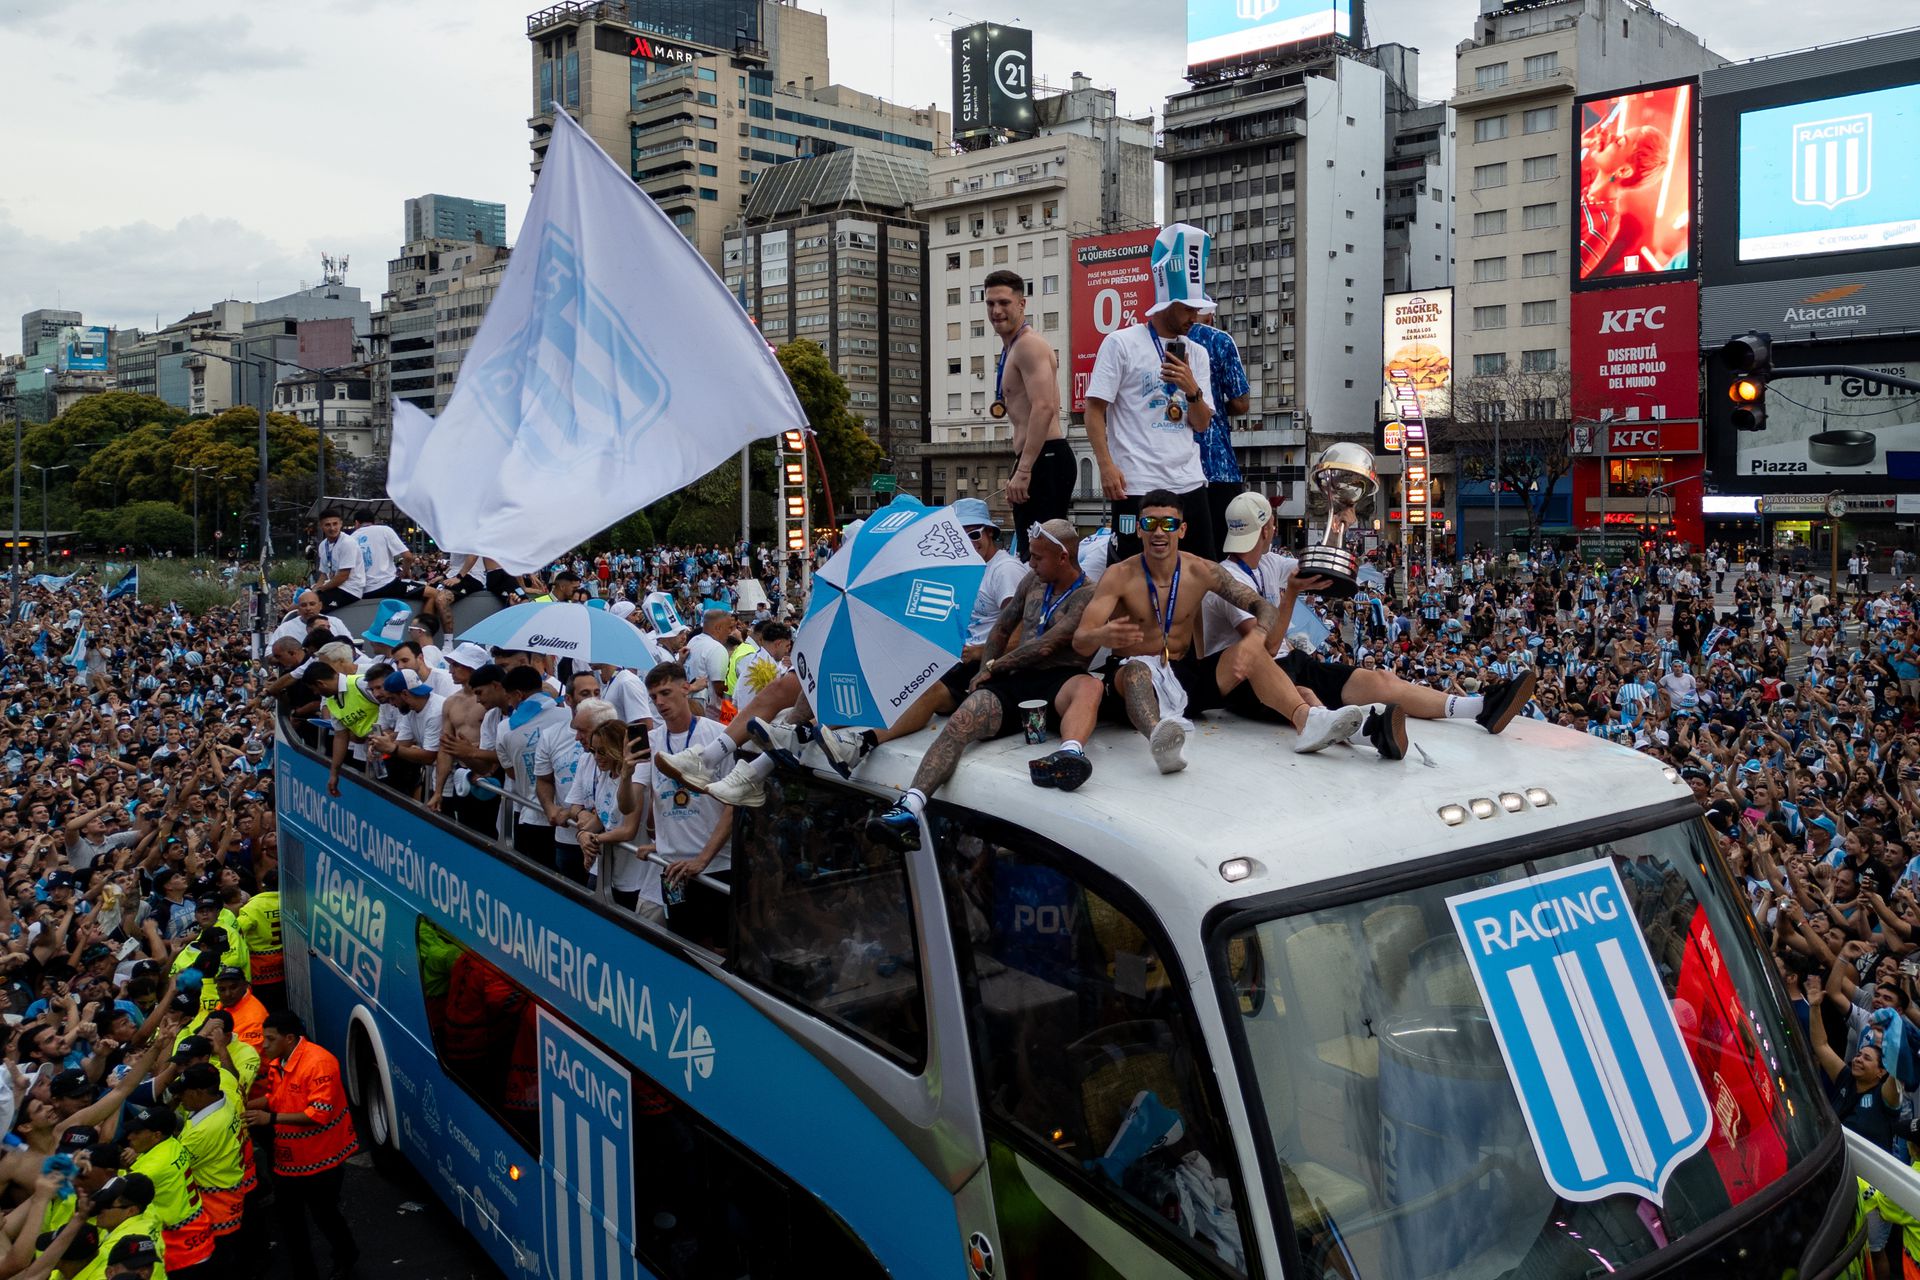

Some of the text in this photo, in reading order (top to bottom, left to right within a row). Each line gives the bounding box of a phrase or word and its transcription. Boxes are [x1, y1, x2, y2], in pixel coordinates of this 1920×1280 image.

[654, 45, 693, 62] MARR
[962, 37, 971, 121] CENTURY 21
[1005, 62, 1026, 87] 21
[1800, 122, 1865, 142] RACING
[1077, 245, 1149, 262] LA QUERÉS CONTAR
[1188, 245, 1200, 284] RCA
[1111, 273, 1149, 285] PRÉSTAMO
[1123, 291, 1138, 299] TASA
[1123, 299, 1138, 307] CERO
[1094, 288, 1122, 334] 0
[1395, 303, 1442, 316] STACKER
[1395, 312, 1438, 325] ONION XL
[1783, 304, 1867, 322] Atacama
[1598, 305, 1666, 334] KFC
[1608, 343, 1657, 362] DISFRUTÁ
[1600, 361, 1667, 376] EL MEJOR POLLO
[1609, 375, 1657, 389] DEL MUNDO
[1612, 430, 1658, 447] KFC
[1751, 459, 1808, 473] Piazza
[1766, 495, 1825, 503] MAXIKIOSCO
[1604, 513, 1636, 523] KFC
[941, 520, 969, 558] Kappa
[909, 583, 923, 613] RACING
[527, 633, 579, 651] Quilmes
[832, 675, 856, 685] RACING
[890, 660, 940, 708] betsson
[315, 851, 387, 952] flecha
[292, 777, 658, 1052] RACING CLUB CAMPEÓN COPA SUDAMERICANA
[1473, 885, 1619, 956] RACING
[313, 913, 378, 1001] BUS
[545, 1036, 623, 1130] RACING
